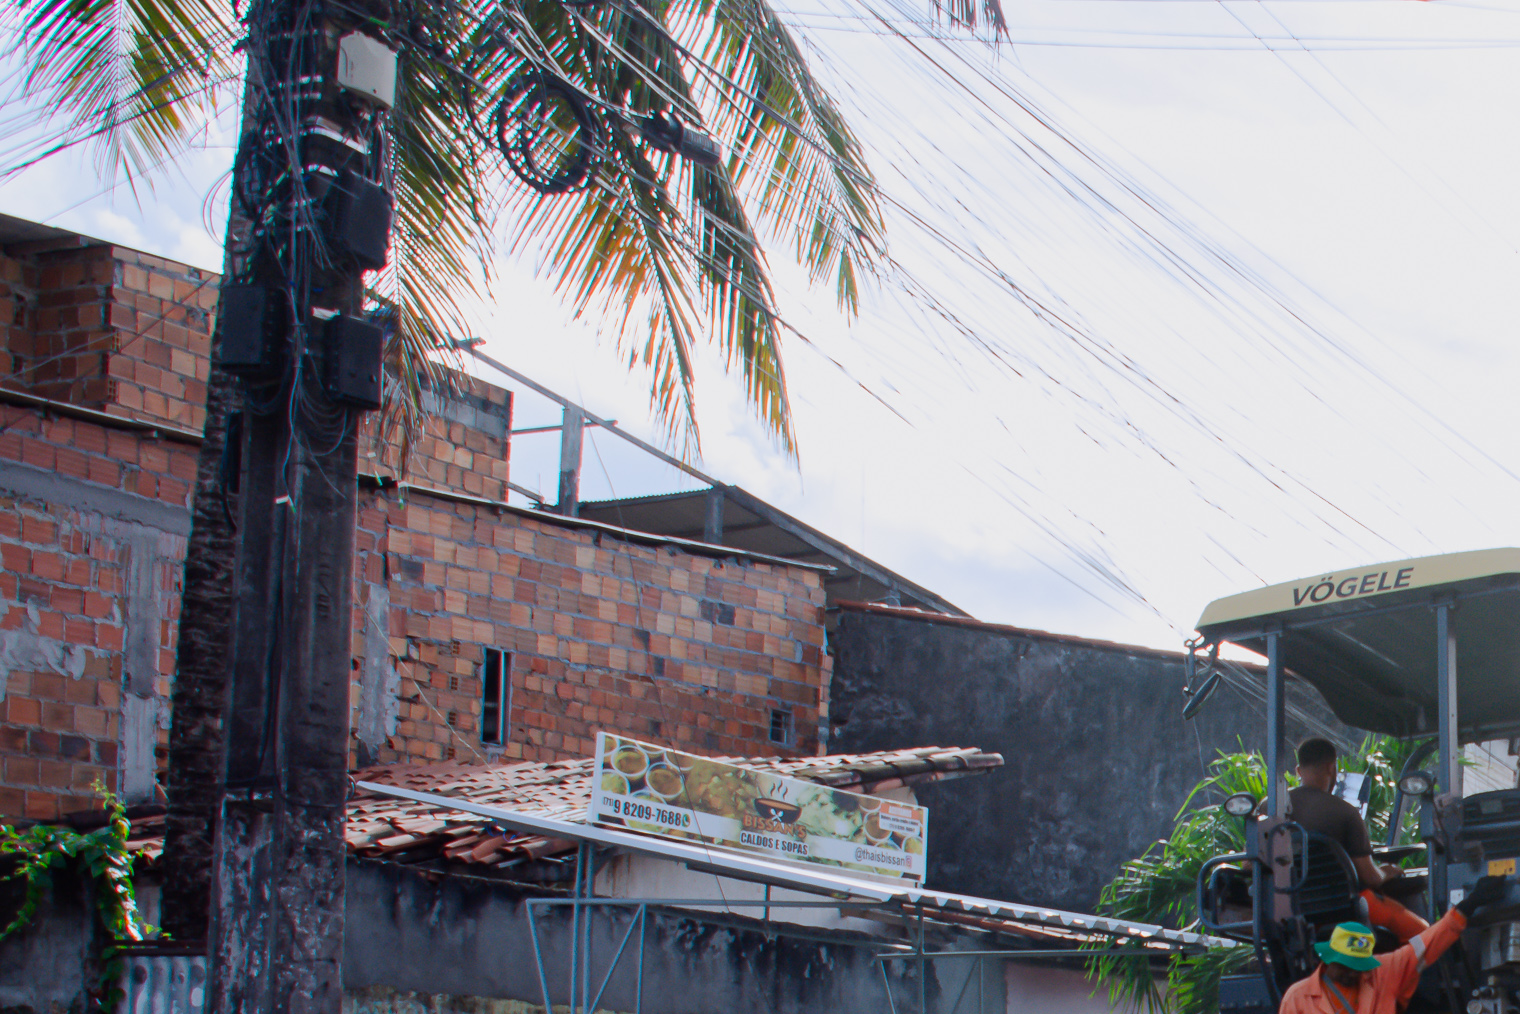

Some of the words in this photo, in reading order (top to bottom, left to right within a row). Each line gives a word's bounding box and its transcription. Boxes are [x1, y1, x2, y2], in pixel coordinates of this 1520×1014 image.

[1293, 567, 1415, 607] VÖGELE
[623, 801, 682, 827] 8209-7688
[743, 813, 808, 840] BISSAN'S
[740, 832, 774, 849] CALDOS
[775, 839, 780, 850] E
[781, 840, 808, 855] SOPAS
[855, 846, 905, 867] @thaisbissan
